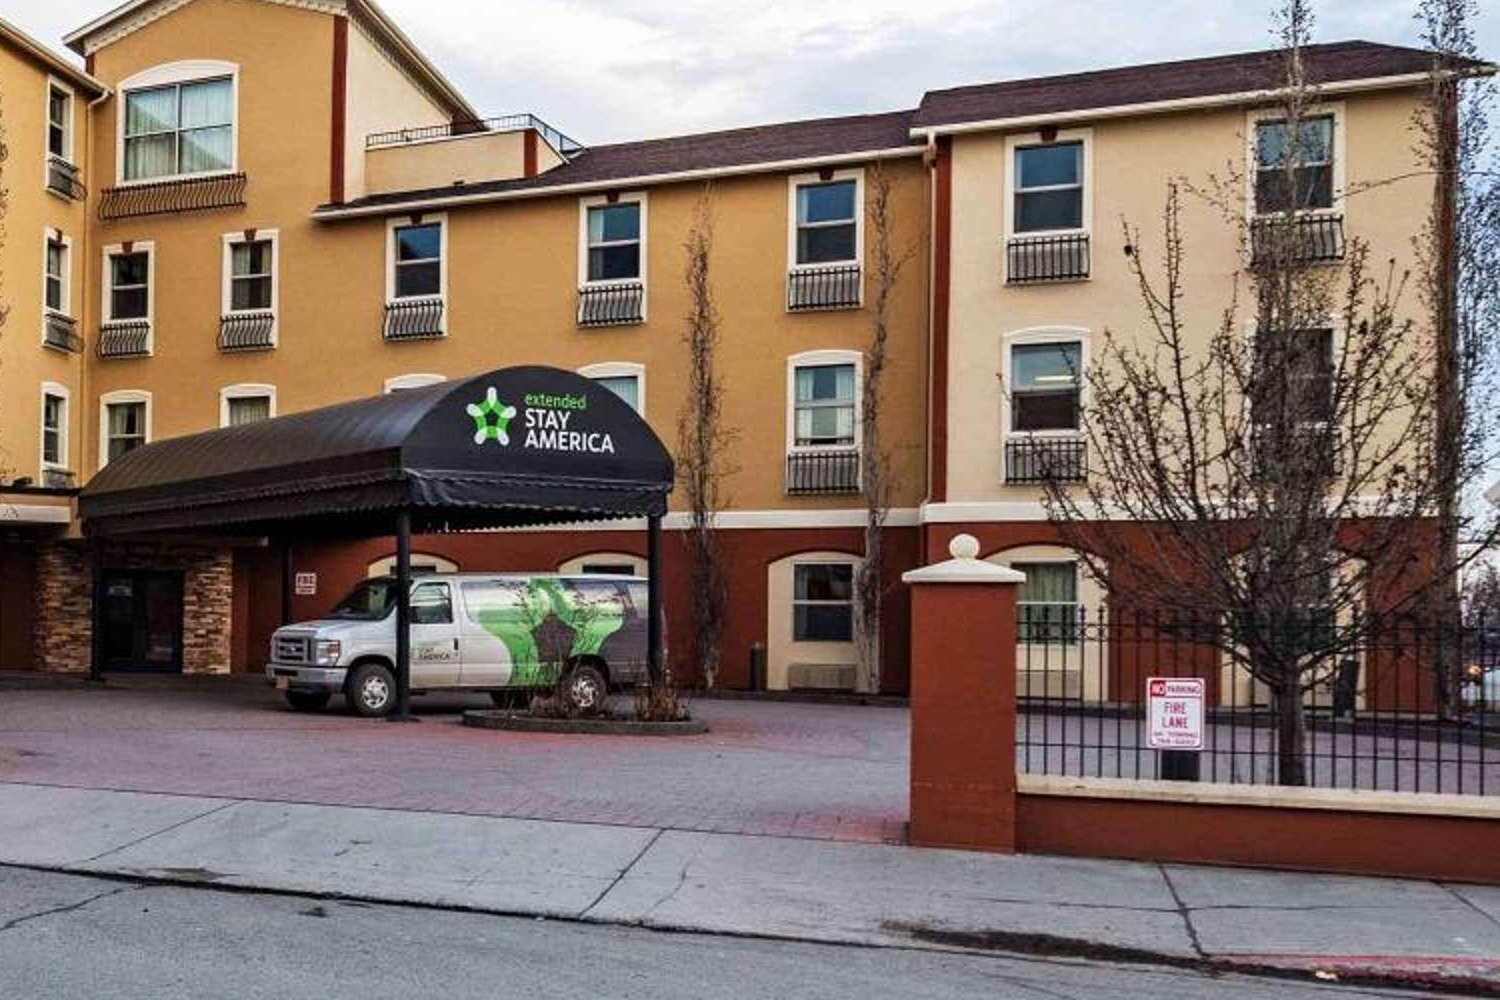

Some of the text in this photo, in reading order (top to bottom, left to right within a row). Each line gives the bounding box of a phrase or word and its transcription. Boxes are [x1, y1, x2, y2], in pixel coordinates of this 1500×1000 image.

[524, 394, 587, 409] extended
[524, 408, 571, 430] STAY
[524, 430, 615, 453] AMERICA
[1167, 686, 1199, 694] PARKING
[1164, 702, 1187, 714] FIRE
[1163, 717, 1188, 728] LANE
